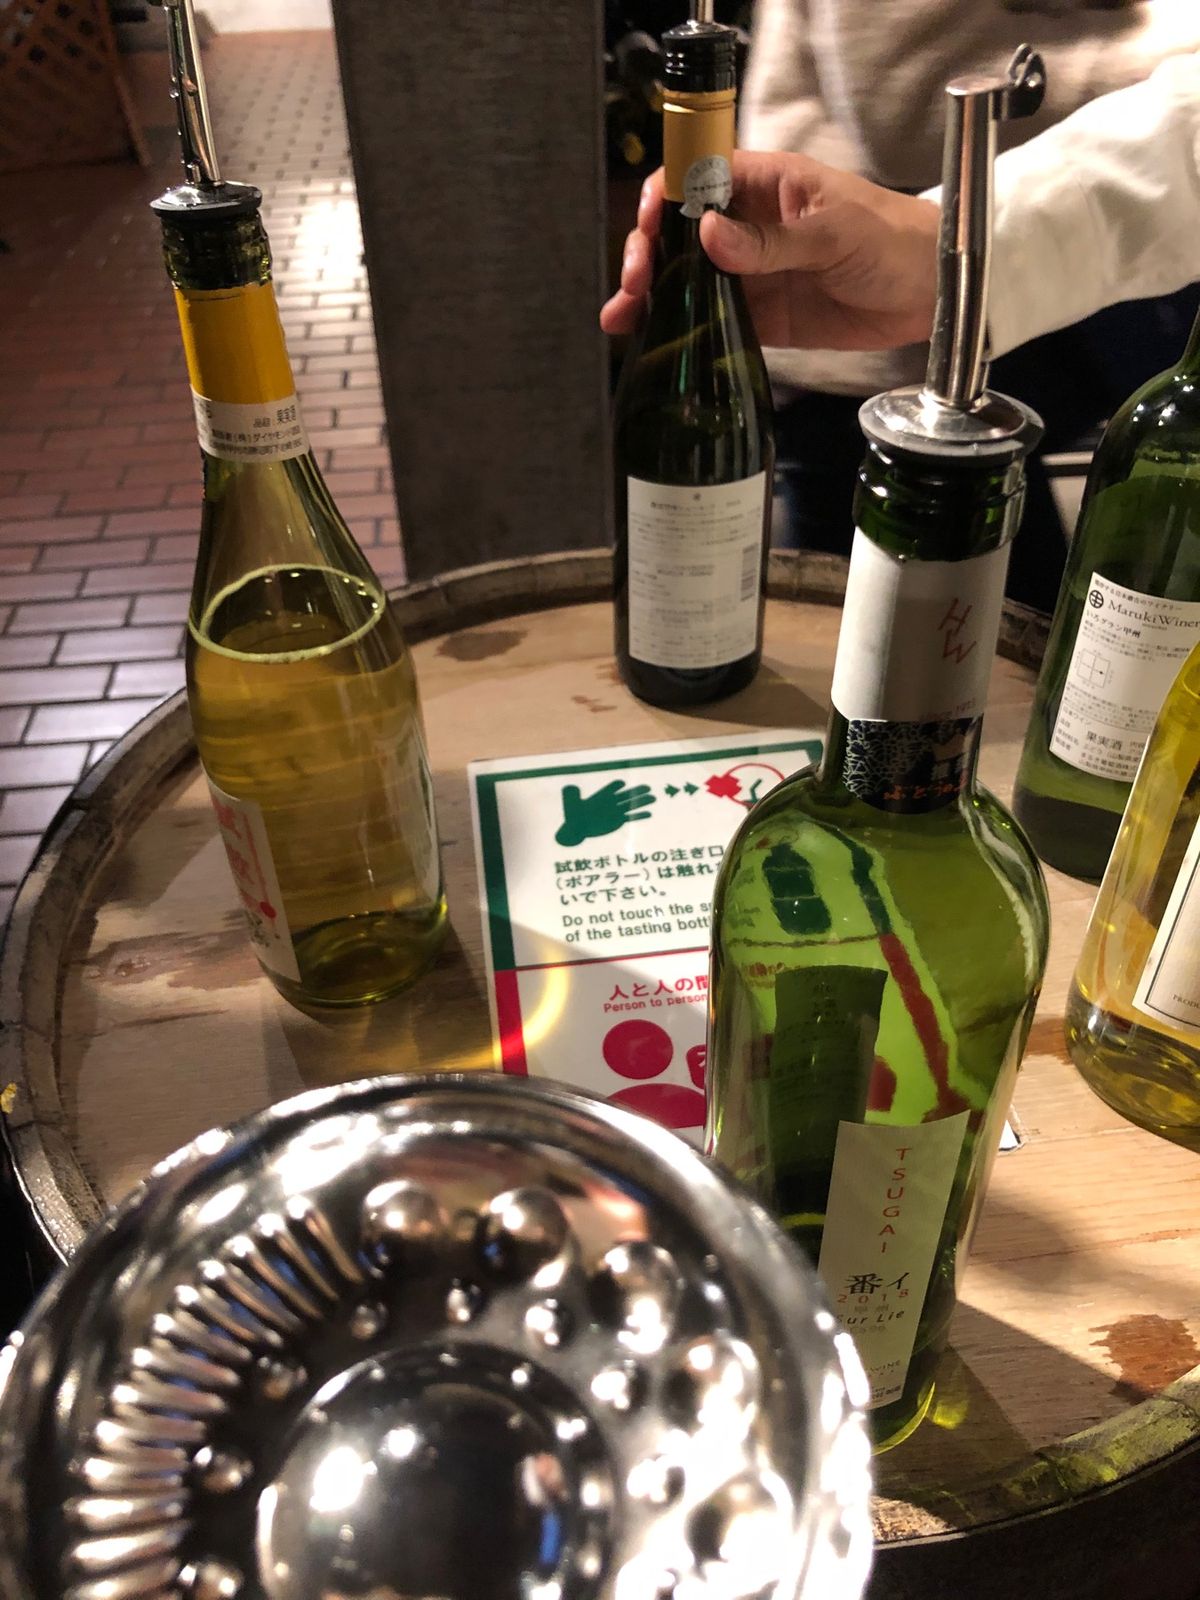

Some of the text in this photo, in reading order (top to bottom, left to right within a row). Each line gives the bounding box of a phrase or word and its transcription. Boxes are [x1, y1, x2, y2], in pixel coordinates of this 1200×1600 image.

[1108, 599, 1200, 629] MarukiWiner
[1087, 731, 1122, 751] 果実酒
[554, 845, 724, 874] 試飲ボトルの注ぎ口
[560, 886, 667, 905] いで下さい。
[562, 914, 583, 927] Do
[589, 911, 614, 924] not
[620, 905, 664, 921] touch
[669, 903, 694, 915] the
[565, 931, 581, 943] of
[587, 928, 612, 940] the
[618, 922, 672, 938] tasting
[603, 993, 708, 1013] Person to person
[879, 1148, 912, 1253] TSUGAI
[844, 1272, 910, 1295] 番イ
[836, 1310, 905, 1325] Sur Lie
